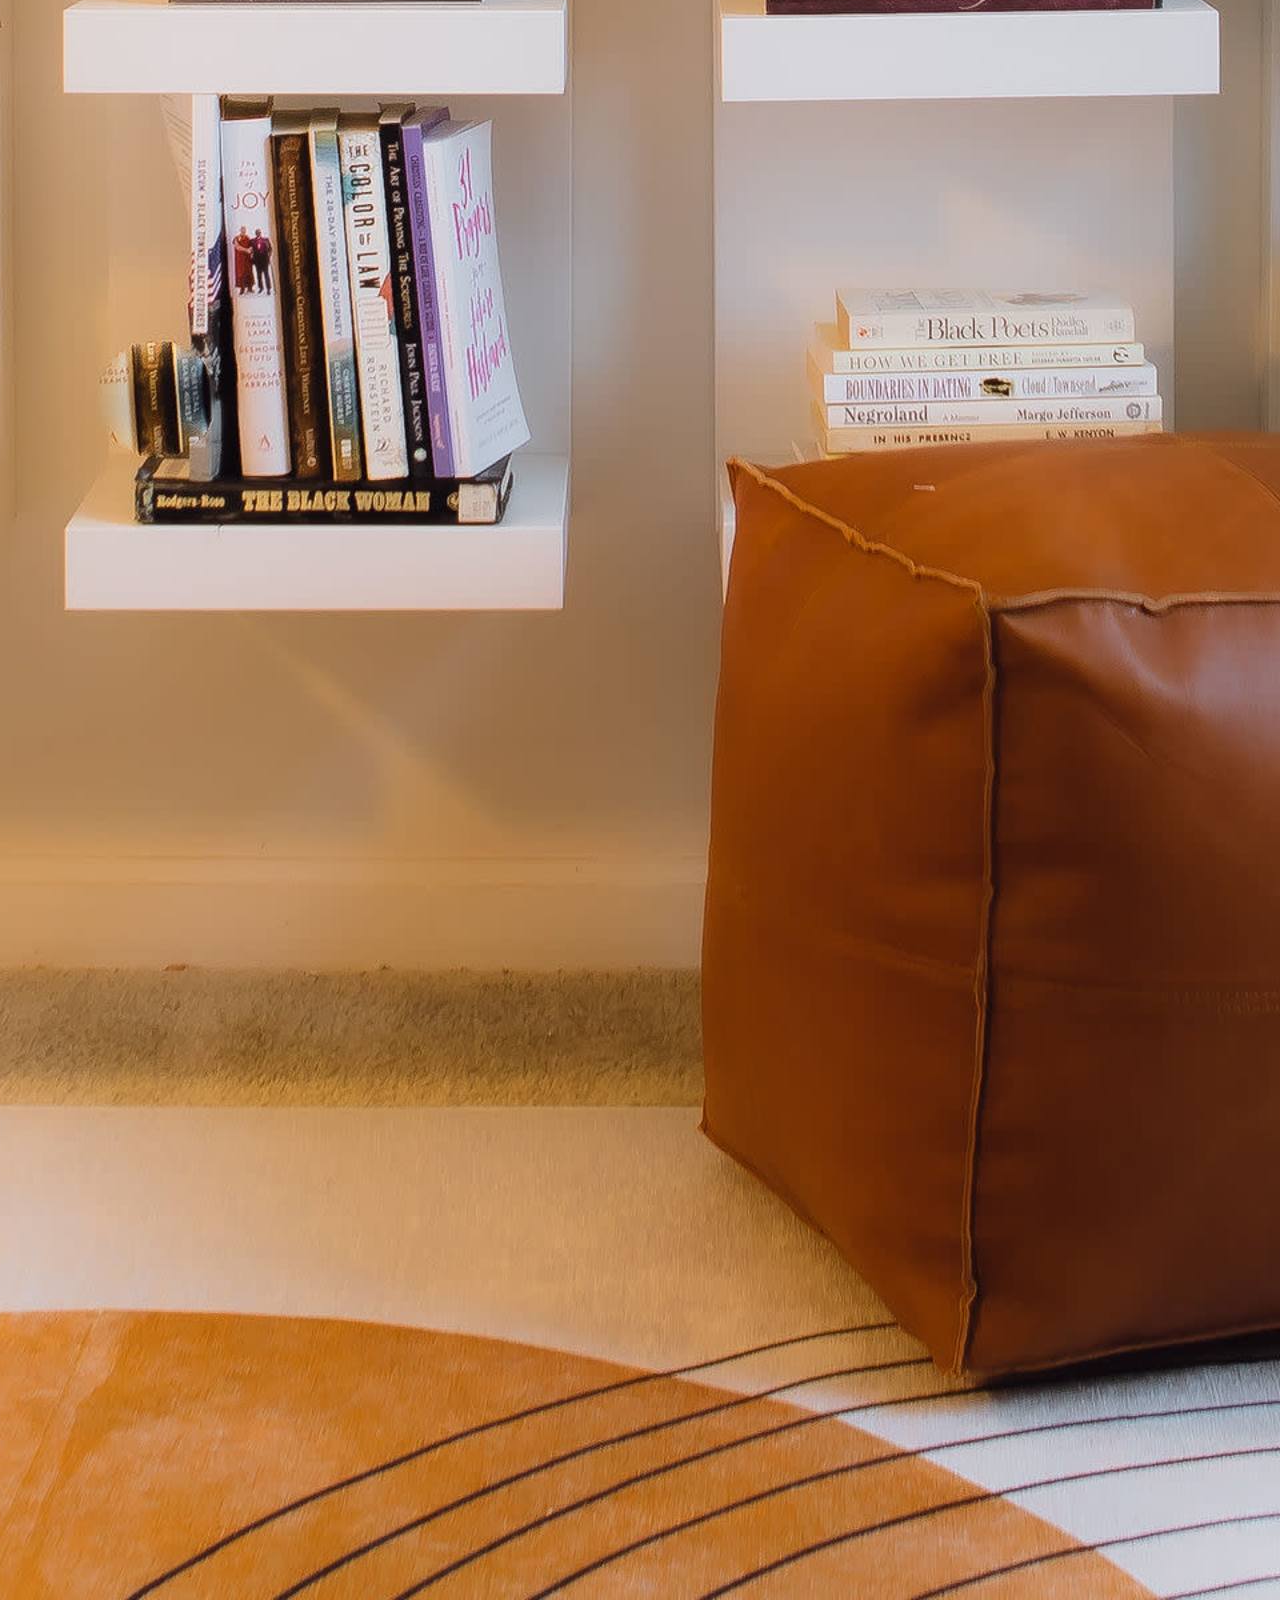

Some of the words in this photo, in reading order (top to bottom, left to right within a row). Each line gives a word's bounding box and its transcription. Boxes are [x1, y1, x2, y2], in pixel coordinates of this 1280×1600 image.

[844, 406, 928, 424] Negroland
[1017, 410, 1054, 422] Margo
[1057, 408, 1111, 420] Jefferson
[243, 491, 282, 511] THE
[287, 491, 350, 512] BLACK
[355, 492, 430, 512] WOMAN
